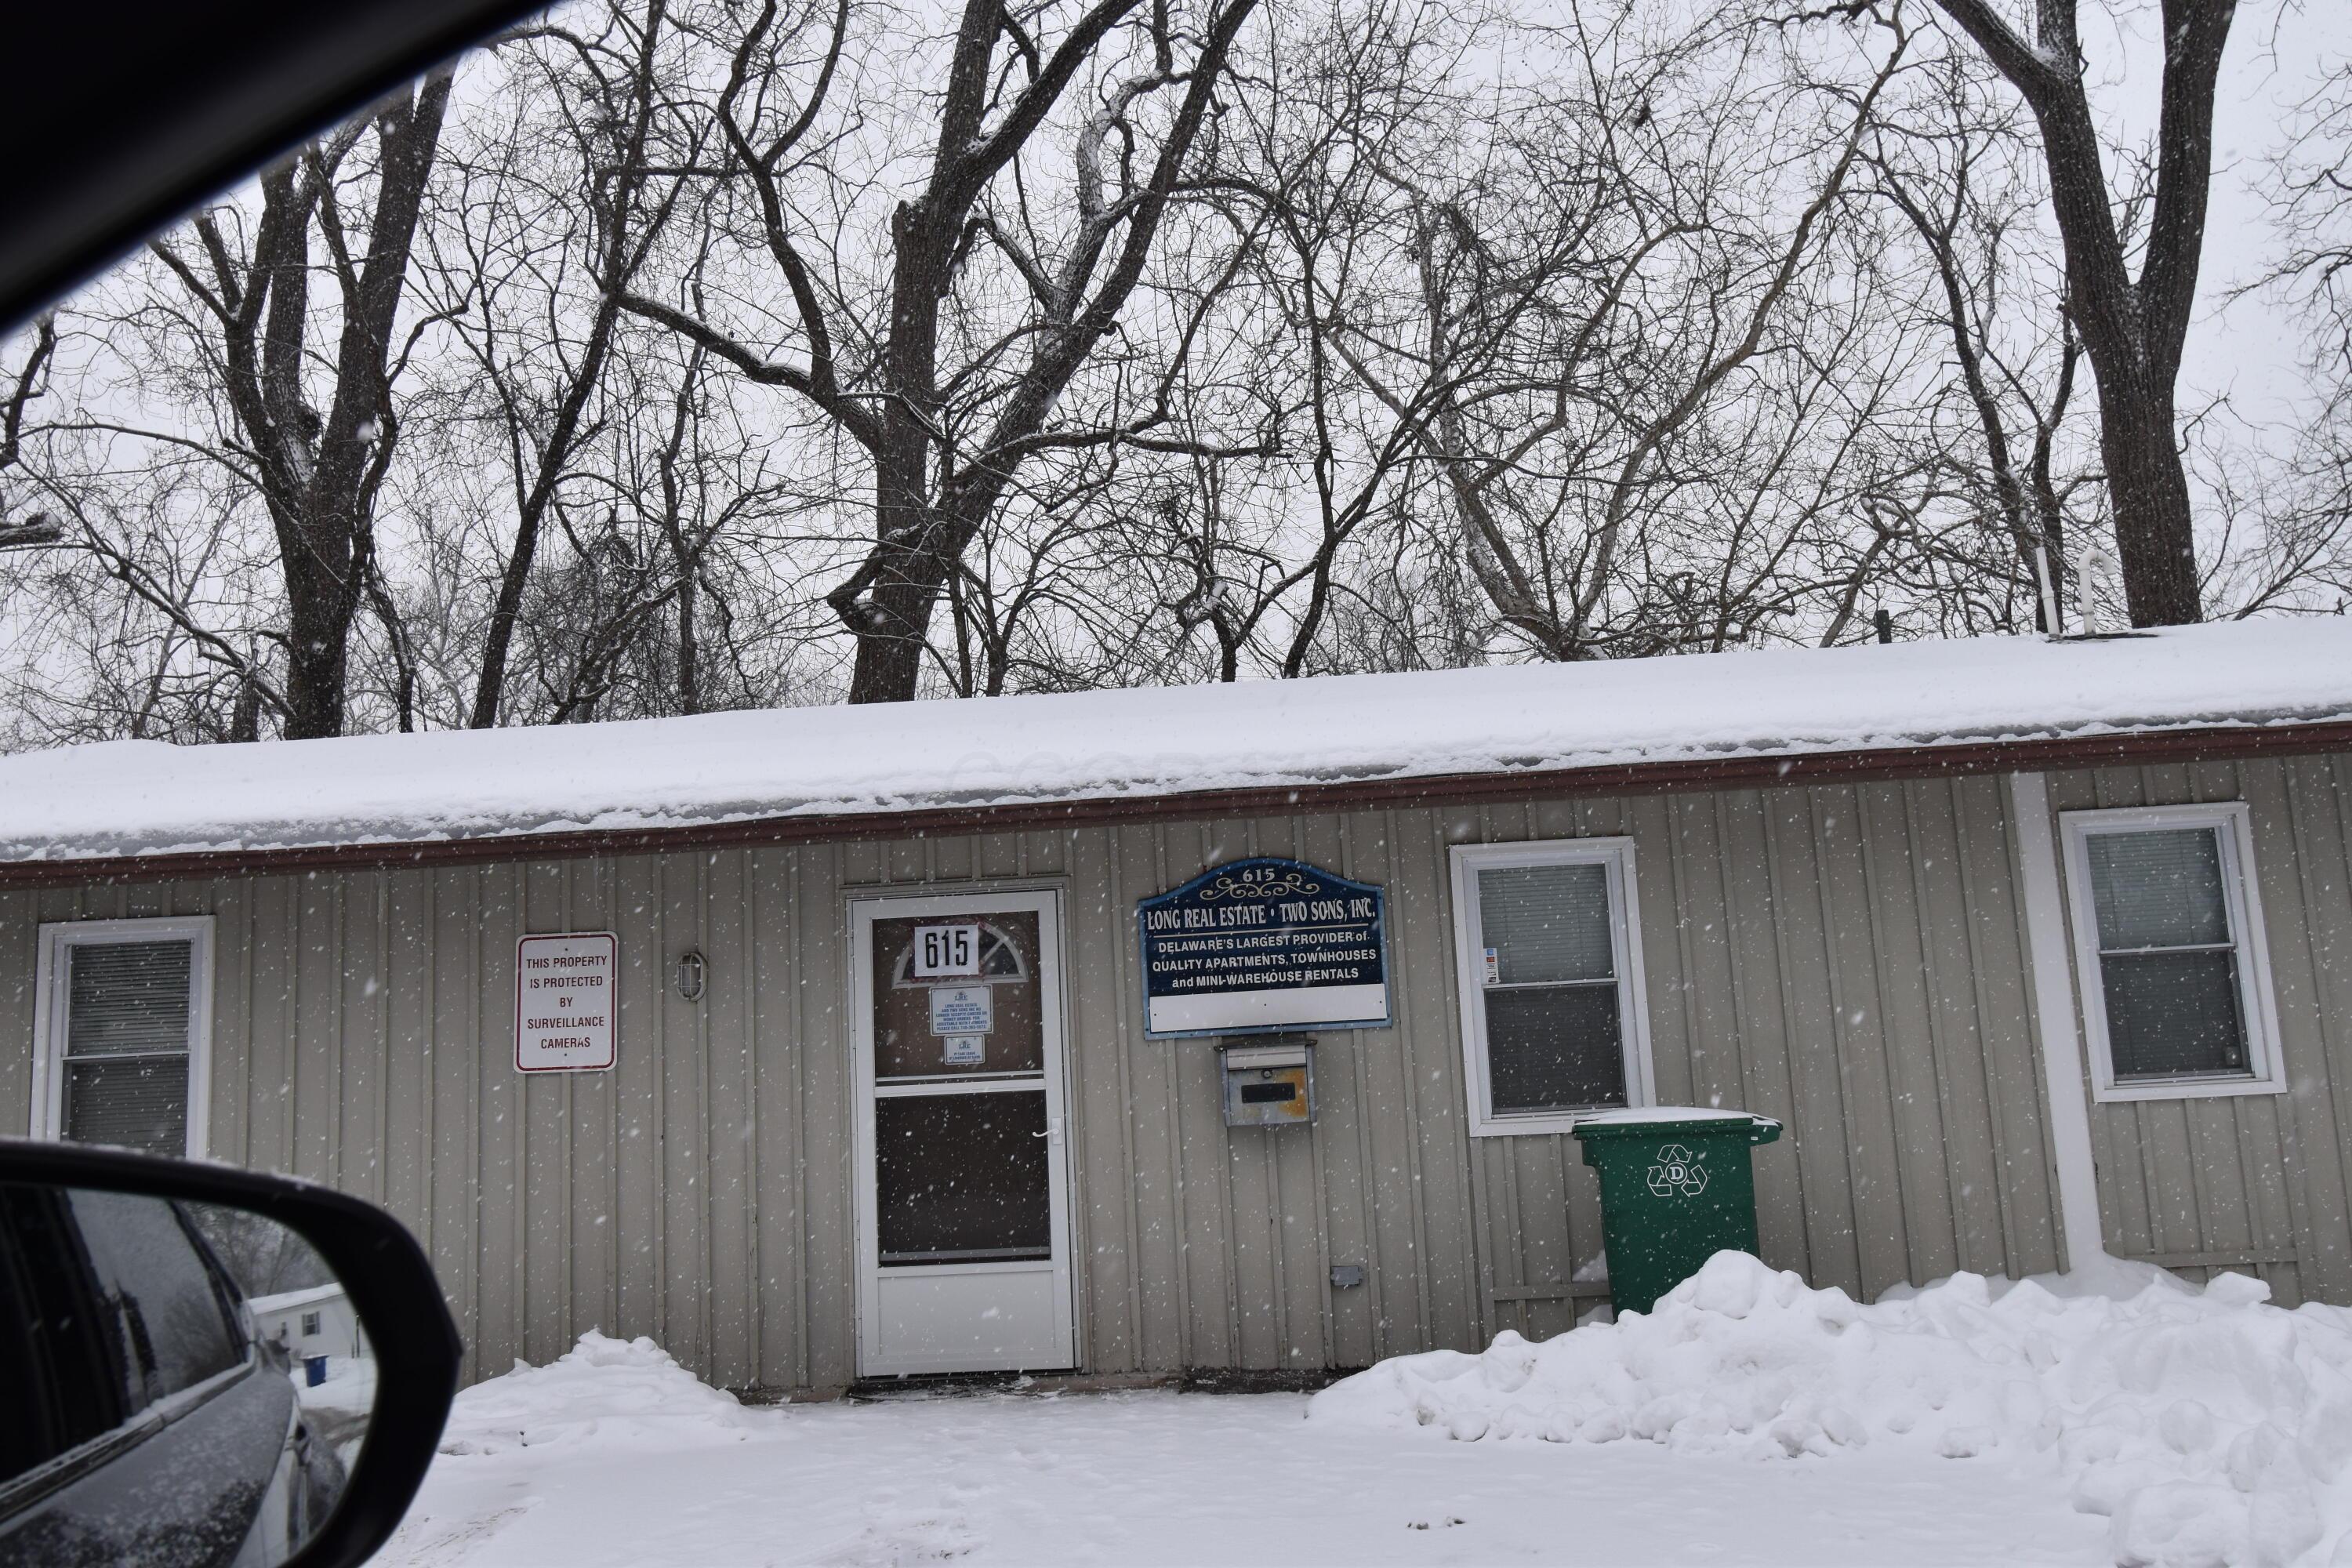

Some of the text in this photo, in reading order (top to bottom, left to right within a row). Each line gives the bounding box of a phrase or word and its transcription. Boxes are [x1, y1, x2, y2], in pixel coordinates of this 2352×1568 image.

[1242, 868, 1276, 883] 615
[1147, 897, 1376, 931] LONG REAL ESTATE TWO SONS, INC.
[1158, 929, 1368, 953] DELAWARE'S LARGEST PROVIDER of
[925, 930, 968, 969] 615
[526, 955, 608, 969] THIS PROPERTY
[1152, 949, 1377, 973] QUALITY APARTMENTS, TOWNHOUSES
[530, 975, 603, 989] IS PROTECTED
[1172, 967, 1359, 989] and MINI-WAREHOUSE RENTALS
[560, 996, 573, 1007] BY
[528, 1016, 604, 1029] SURVEILLANCE
[541, 1036, 590, 1049] CAMERAS
[1669, 1166, 1684, 1180] D
